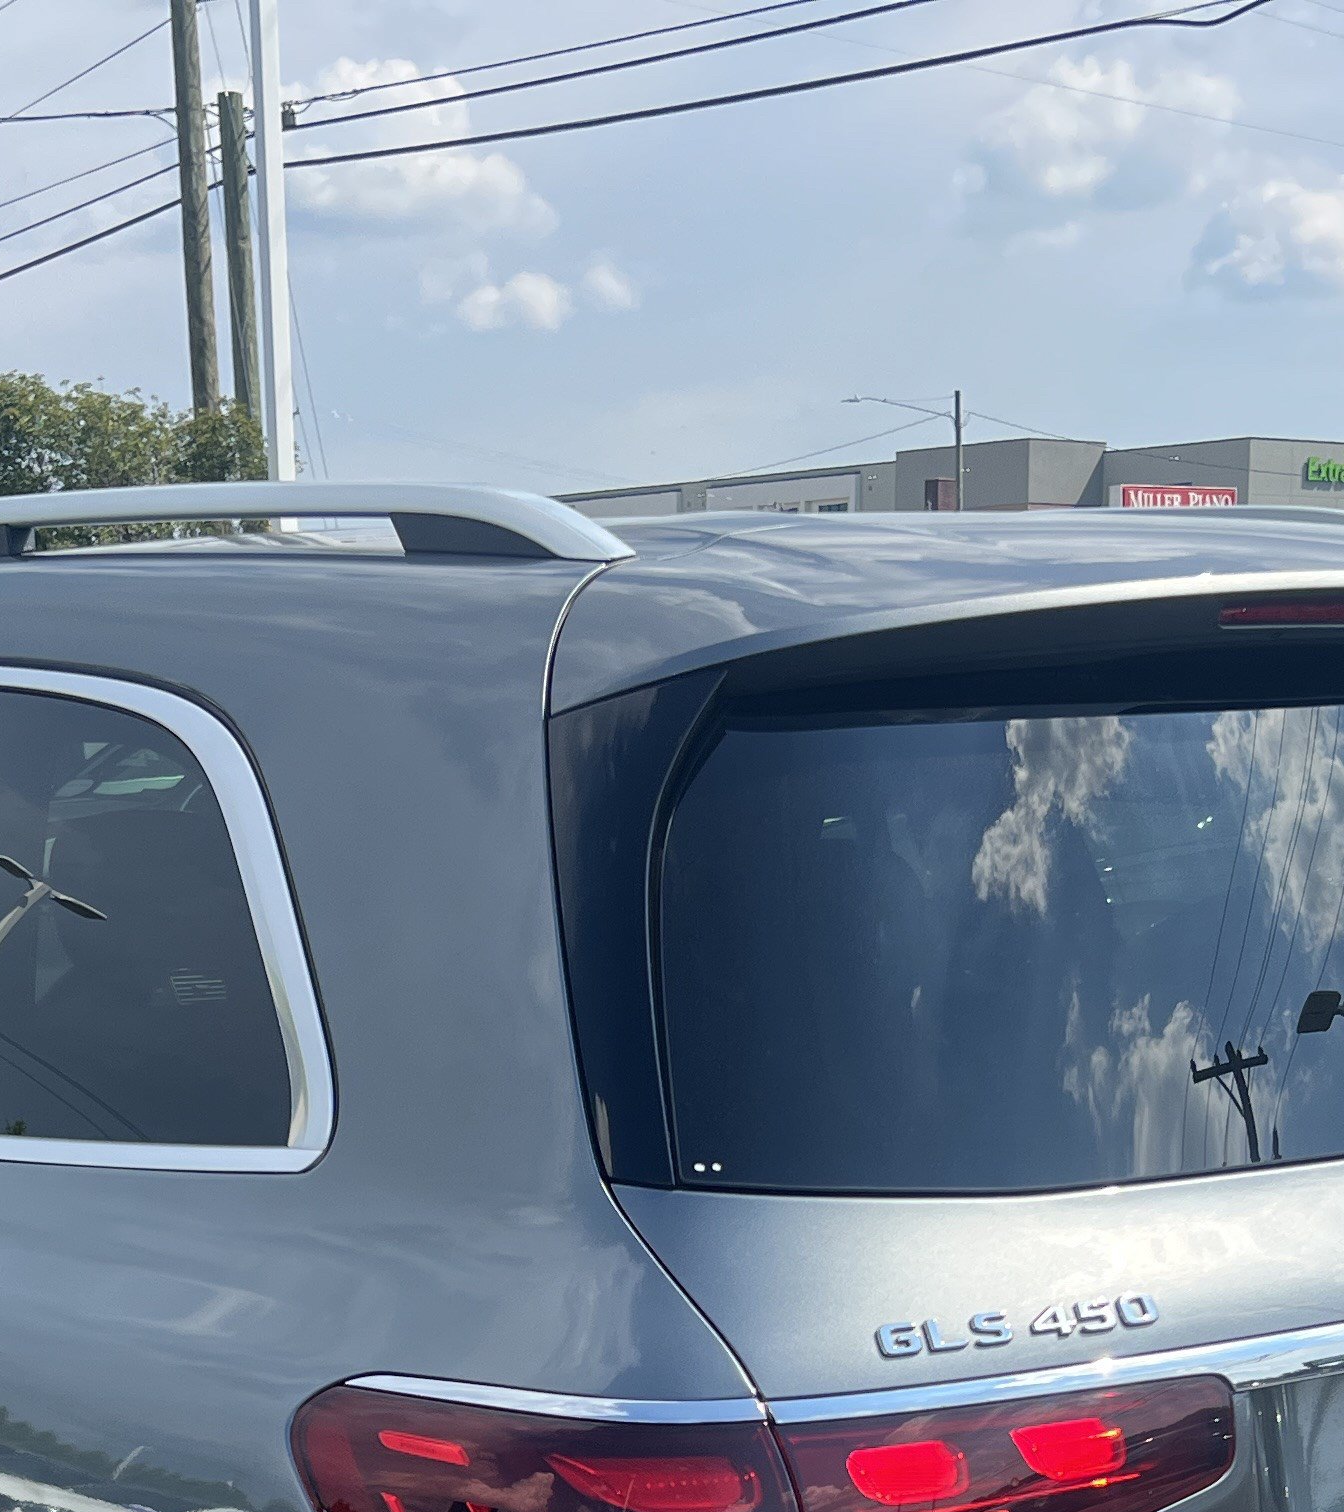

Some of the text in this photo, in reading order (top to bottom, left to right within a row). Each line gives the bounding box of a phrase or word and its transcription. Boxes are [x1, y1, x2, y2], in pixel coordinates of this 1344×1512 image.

[1128, 489, 1233, 508] MILLER PIANO
[874, 1291, 1159, 1360] GLS 450
